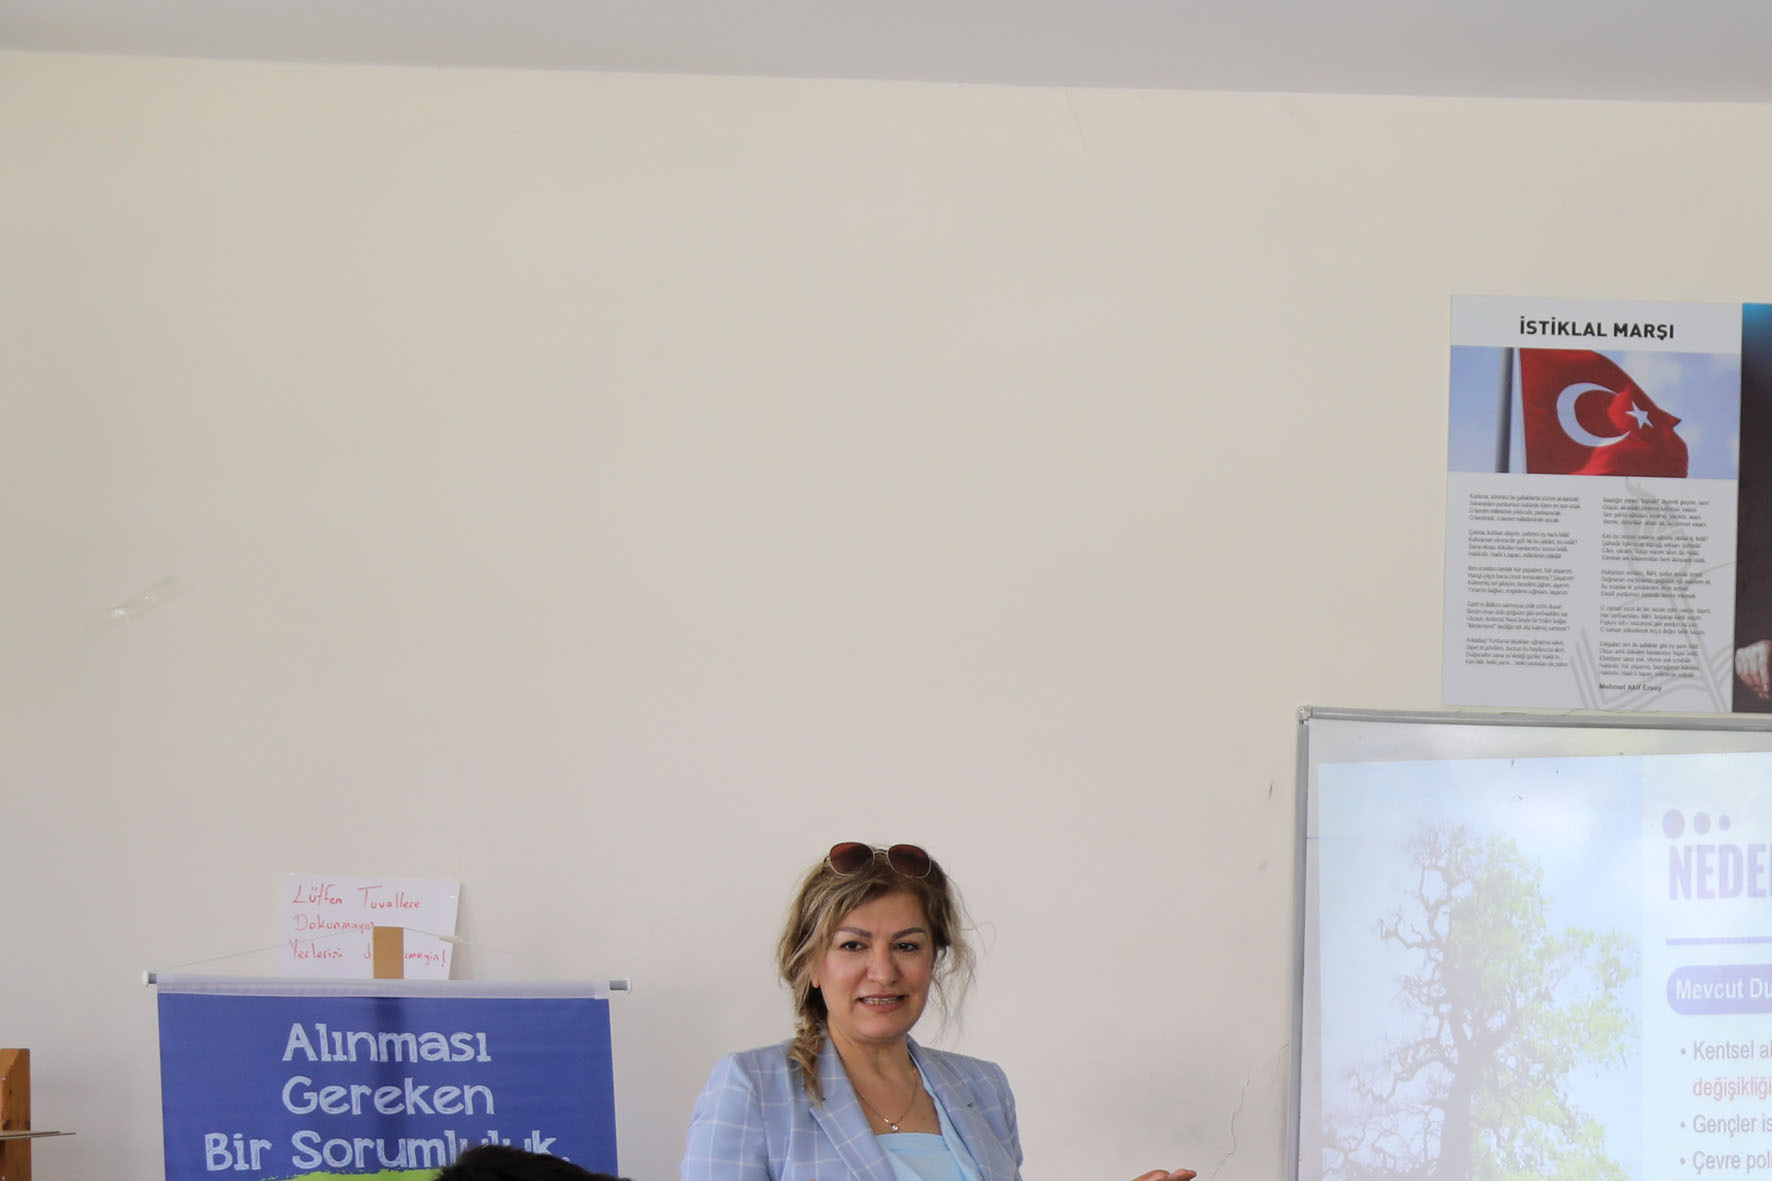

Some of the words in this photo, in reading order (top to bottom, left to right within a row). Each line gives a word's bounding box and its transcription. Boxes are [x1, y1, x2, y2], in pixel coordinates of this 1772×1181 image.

[1519, 315, 1607, 338] İSTİKLAL
[1613, 321, 1675, 341] MARŞI
[292, 883, 343, 905] Lütfen
[1677, 979, 1743, 999] Mevcut
[282, 1022, 491, 1063] Alınması
[1693, 1040, 1754, 1060] Kentsel
[282, 1075, 495, 1116] Gereken
[1693, 1114, 1758, 1139] Gençler
[205, 1132, 272, 1171] Bir
[1692, 1151, 1741, 1175] Çevre
